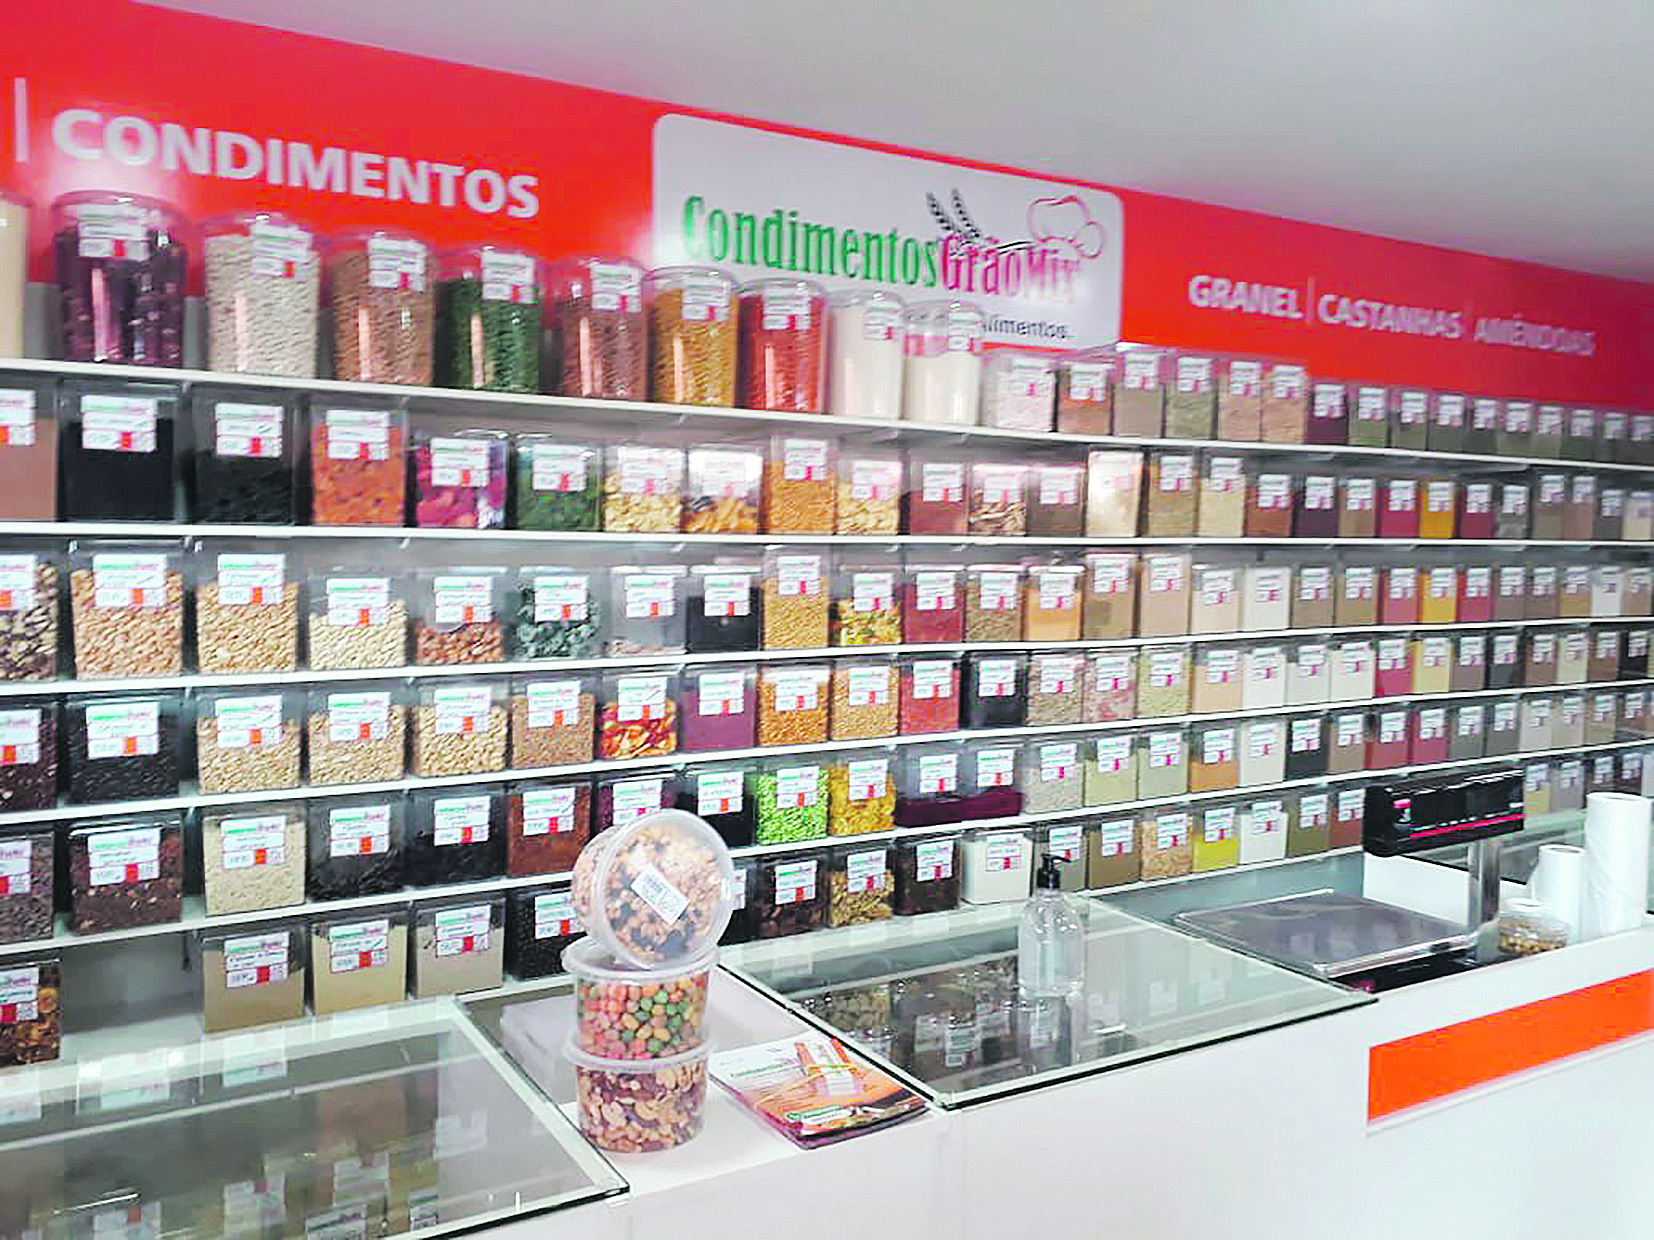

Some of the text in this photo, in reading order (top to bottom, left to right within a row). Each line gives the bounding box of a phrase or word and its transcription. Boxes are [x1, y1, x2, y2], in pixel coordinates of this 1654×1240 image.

[52, 108, 540, 219] CONDIMENTOS
[982, 316, 1067, 339] limentos
[1188, 274, 1303, 319] GRANEL
[1318, 294, 1462, 339] CASTANHAS
